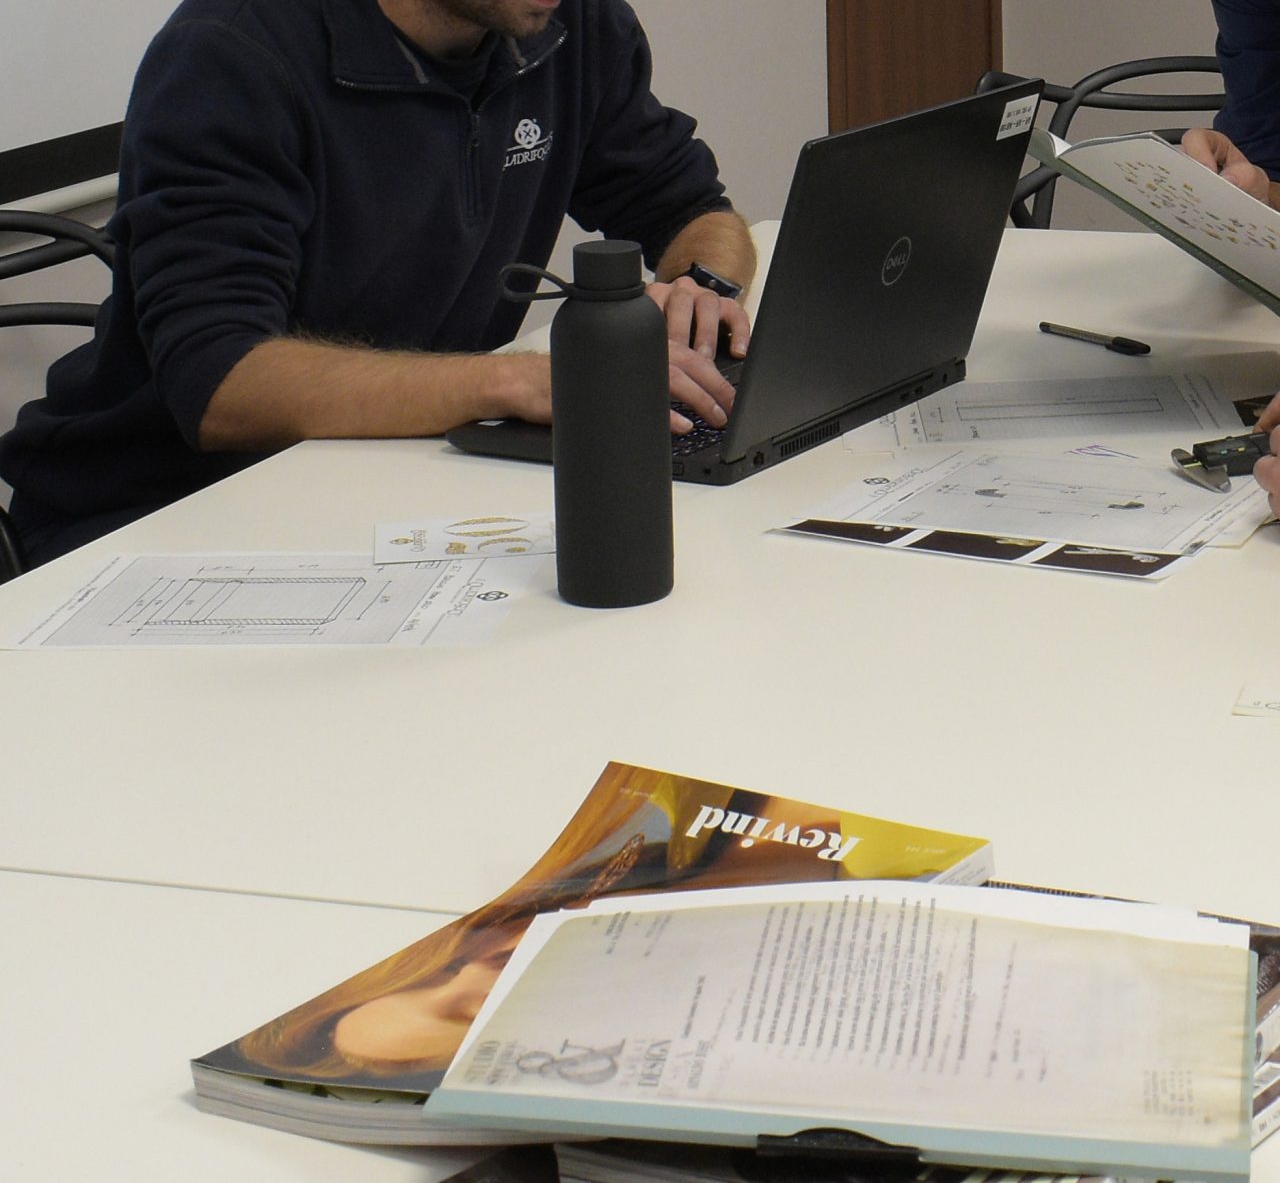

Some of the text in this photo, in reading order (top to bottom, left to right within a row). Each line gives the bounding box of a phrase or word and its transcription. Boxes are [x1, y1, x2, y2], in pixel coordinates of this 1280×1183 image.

[886, 253, 907, 270] DELL
[685, 805, 863, 863] Rewind
[637, 1039, 672, 1088] DESIGN
